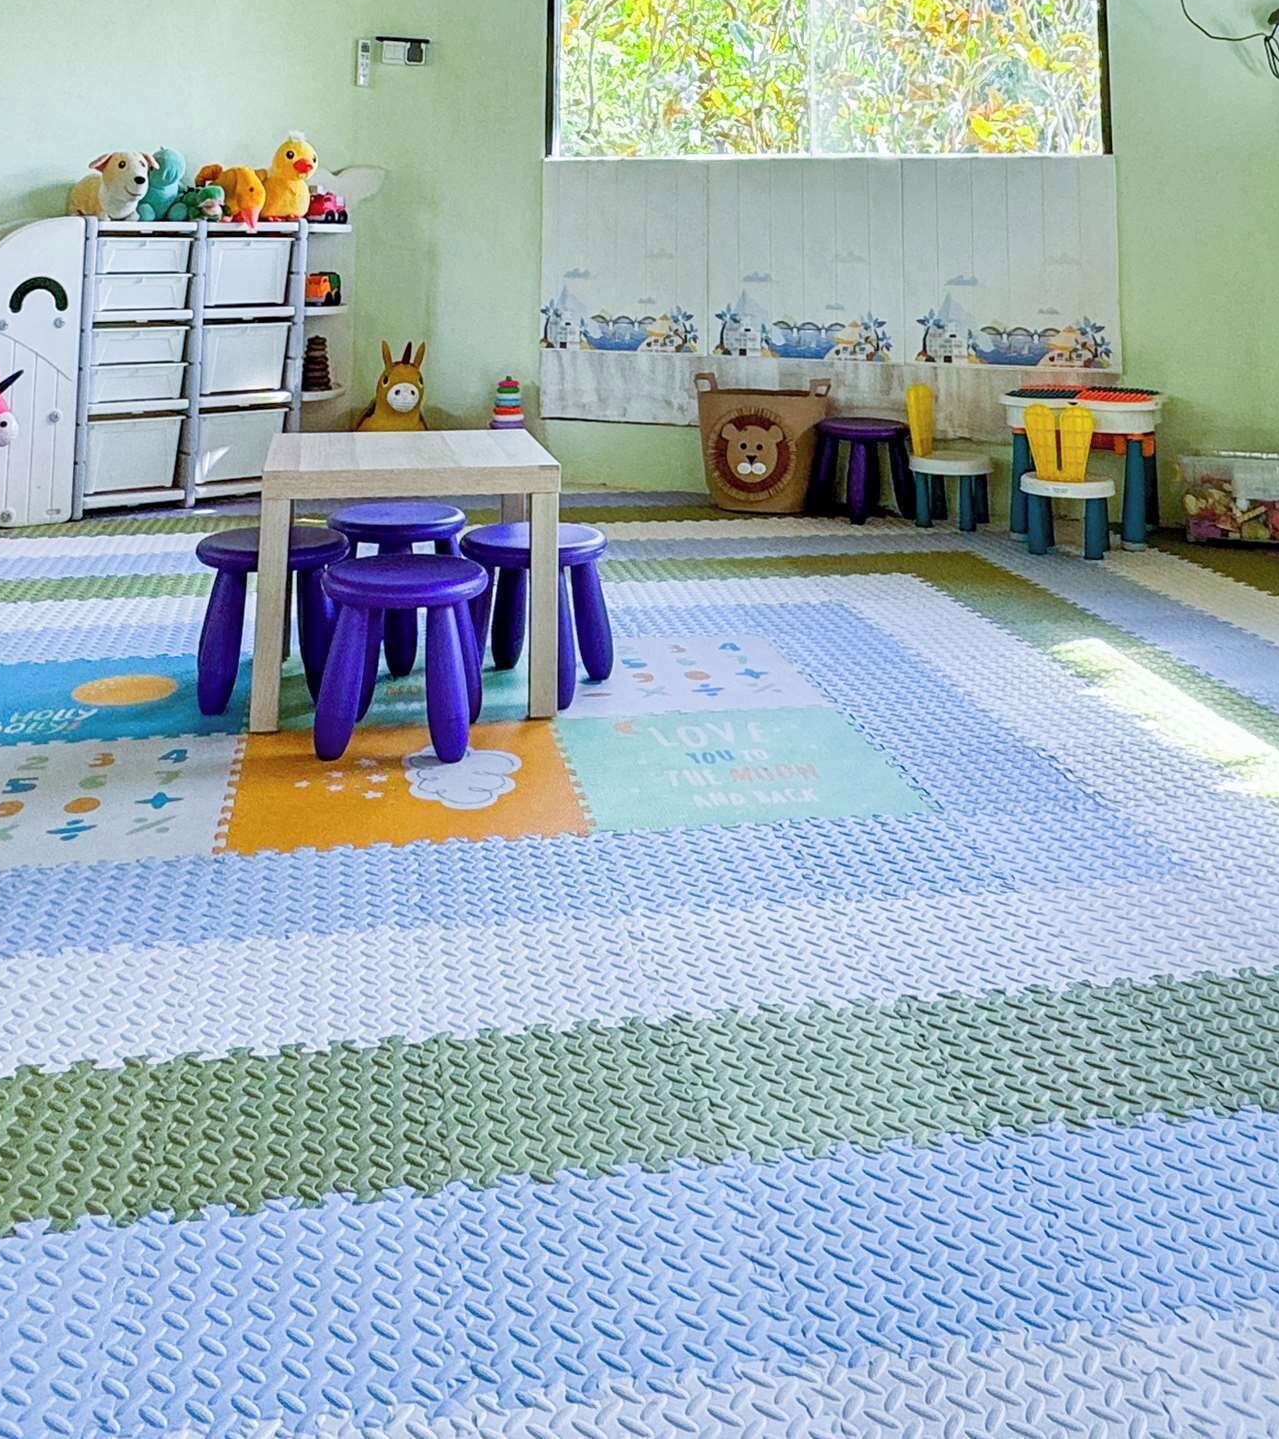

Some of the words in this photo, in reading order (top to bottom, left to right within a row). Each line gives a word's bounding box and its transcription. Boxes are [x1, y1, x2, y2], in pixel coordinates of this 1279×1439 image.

[648, 720, 769, 749] LOVE
[685, 749, 736, 765] YOU
[2, 777, 39, 794] 5
[664, 768, 721, 788] THE
[691, 791, 747, 809] AND
